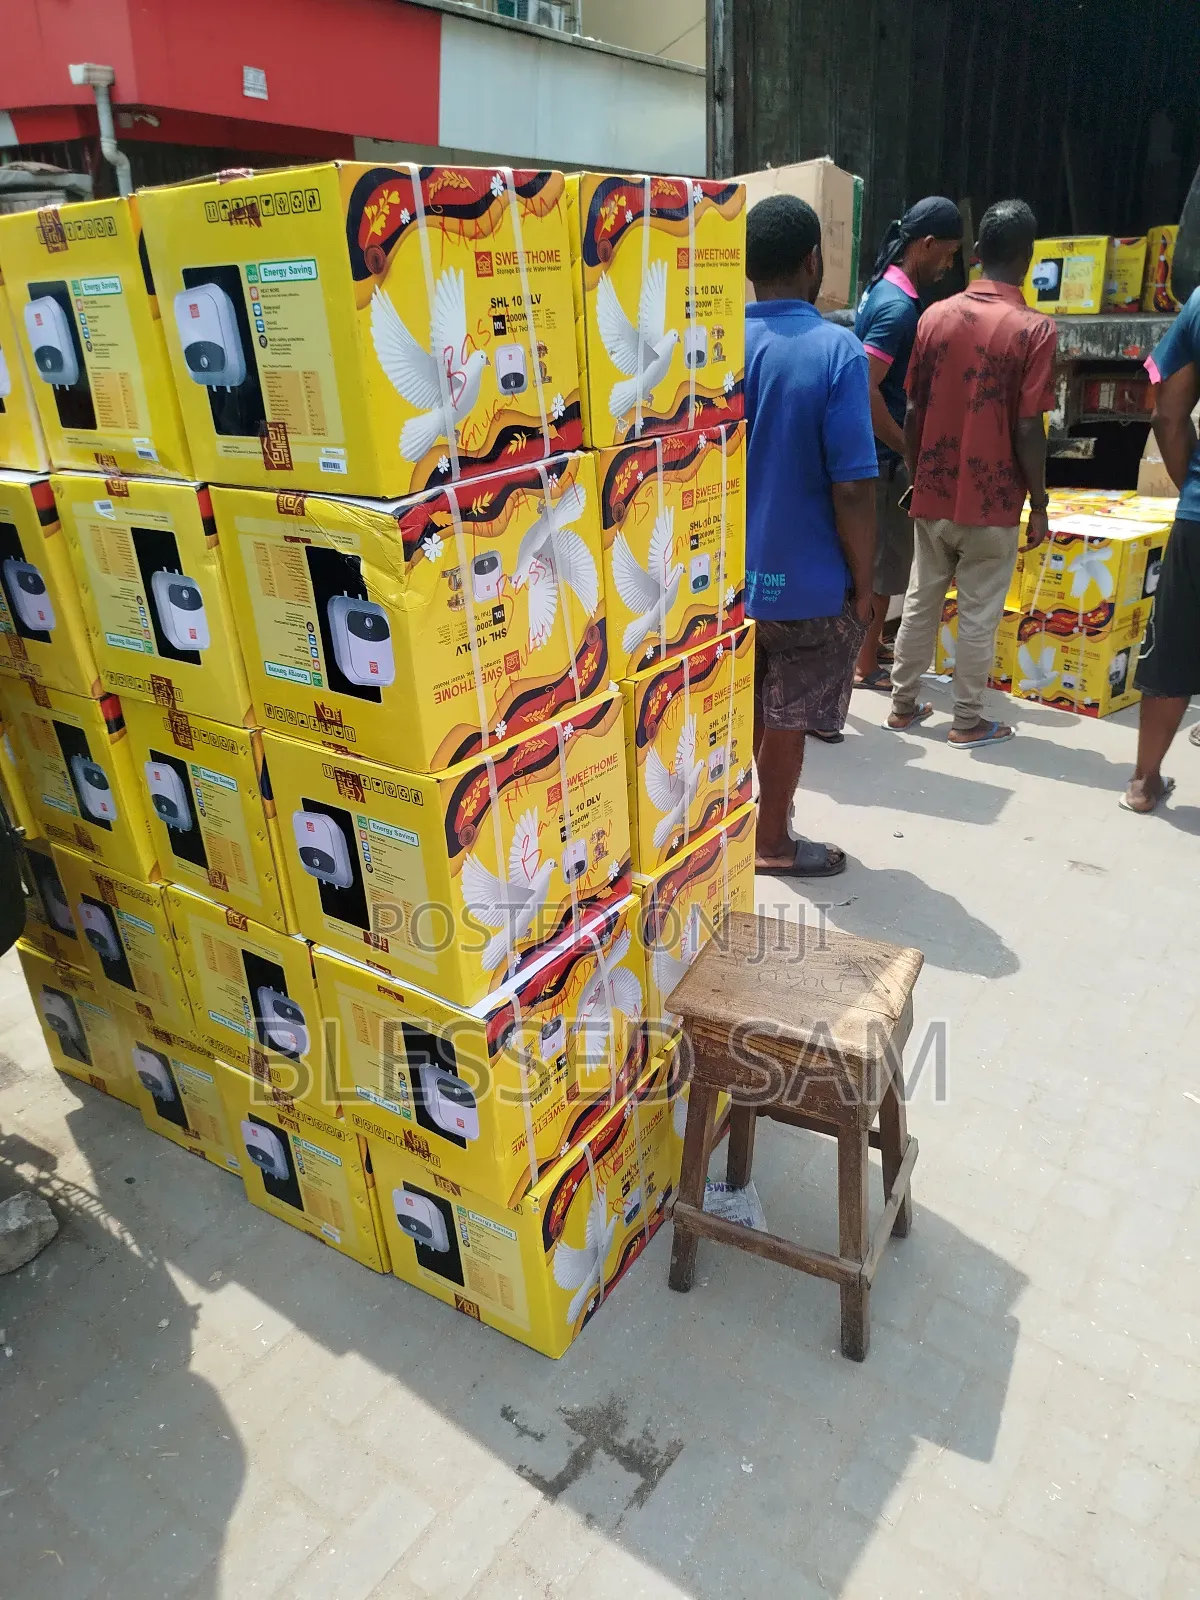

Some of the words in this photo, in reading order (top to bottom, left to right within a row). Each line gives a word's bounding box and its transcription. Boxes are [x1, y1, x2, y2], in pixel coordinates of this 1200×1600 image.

[495, 250, 561, 266] SWETHOME
[263, 267, 287, 278] Energy
[289, 265, 313, 275] Saving
[83, 282, 101, 293] Energy
[102, 280, 119, 291] Saving
[684, 286, 699, 296] SL
[700, 286, 709, 295] 10
[710, 284, 724, 295] DLV
[490, 297, 509, 309] SHL
[511, 295, 522, 307] 10
[525, 294, 542, 305] LV
[506, 313, 528, 323] 2000W
[493, 321, 505, 330] 10L
[689, 520, 702, 531] SHL
[494, 610, 505, 620] 10L
[474, 619, 493, 633] 2000
[489, 628, 508, 642] SHL
[267, 665, 288, 678] Saving
[288, 668, 309, 682] Energy
[433, 667, 503, 704] SWETHOME
[558, 811, 574, 823] SL
[575, 802, 585, 812] 10
[586, 793, 602, 808] DLV
[372, 822, 393, 836] Energy
[394, 830, 415, 843] Saving
